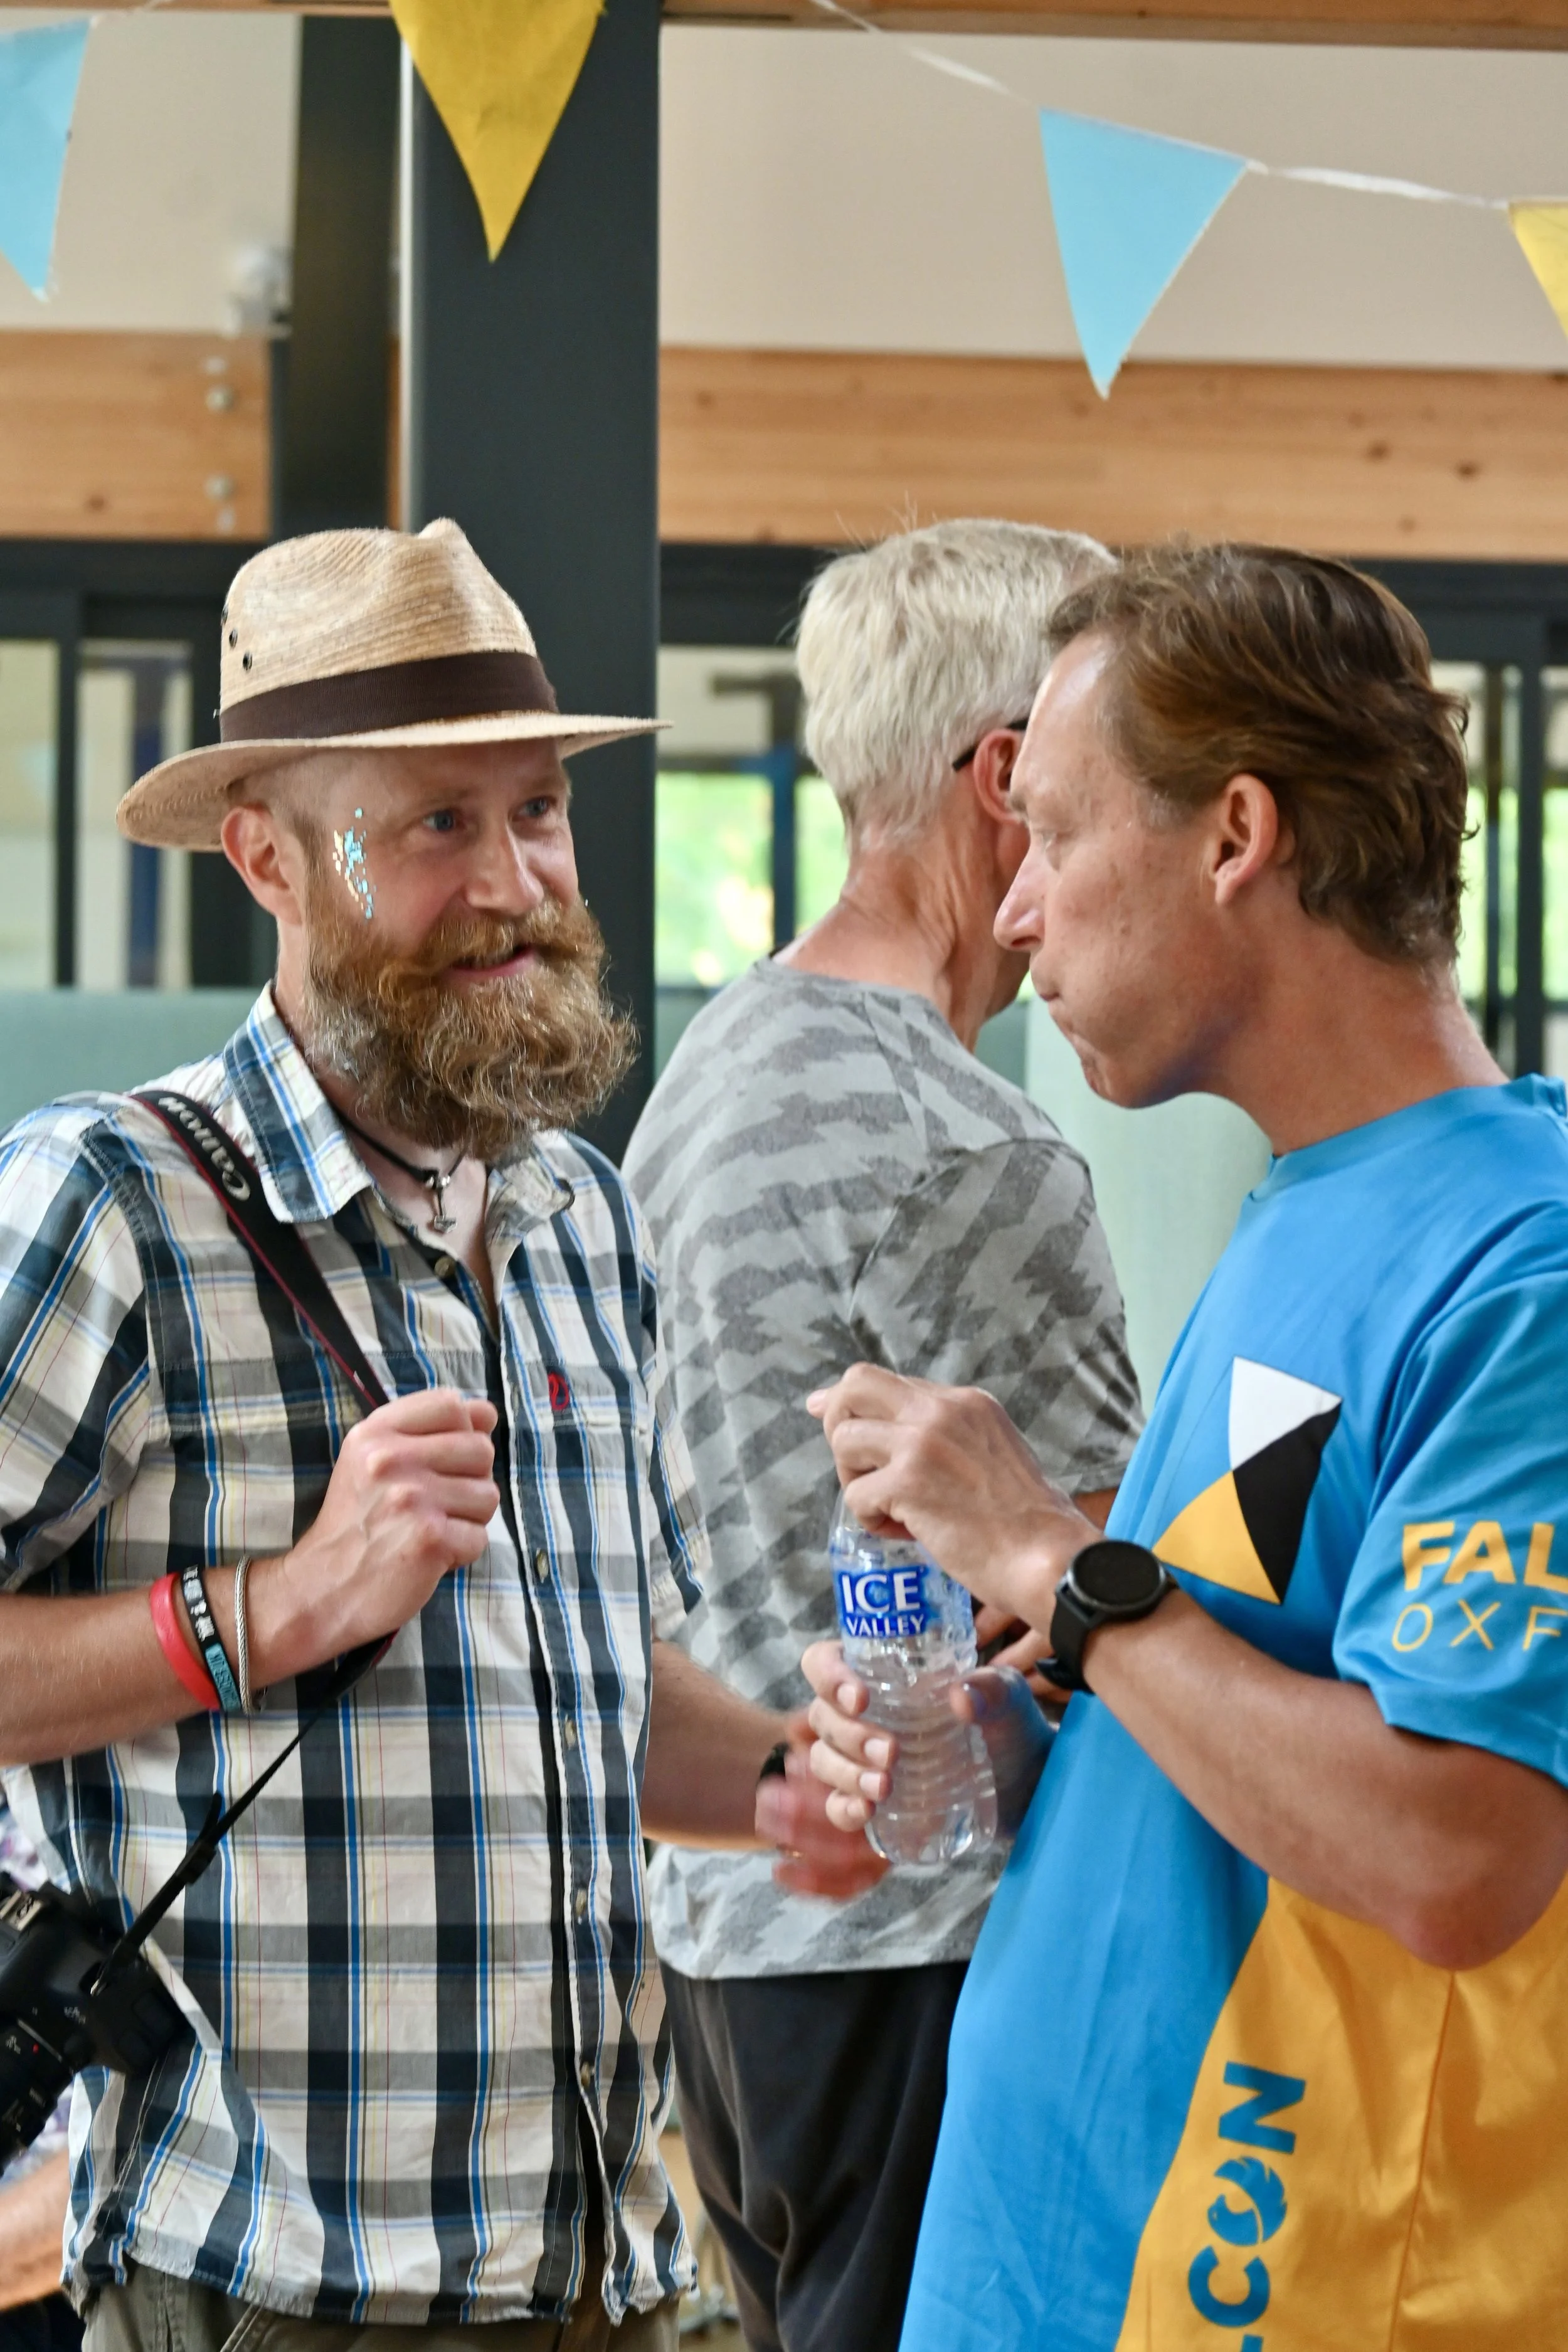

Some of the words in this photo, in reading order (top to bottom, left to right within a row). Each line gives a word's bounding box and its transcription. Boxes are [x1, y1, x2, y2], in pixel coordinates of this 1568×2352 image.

[158, 1096, 251, 1201] Canon
[1402, 1520, 1568, 1595] FAL
[841, 1571, 921, 1614] ICE
[846, 1613, 924, 1637] VALLEY
[1391, 1597, 1568, 1652] OXF
[1188, 2060, 1306, 2352] CON
